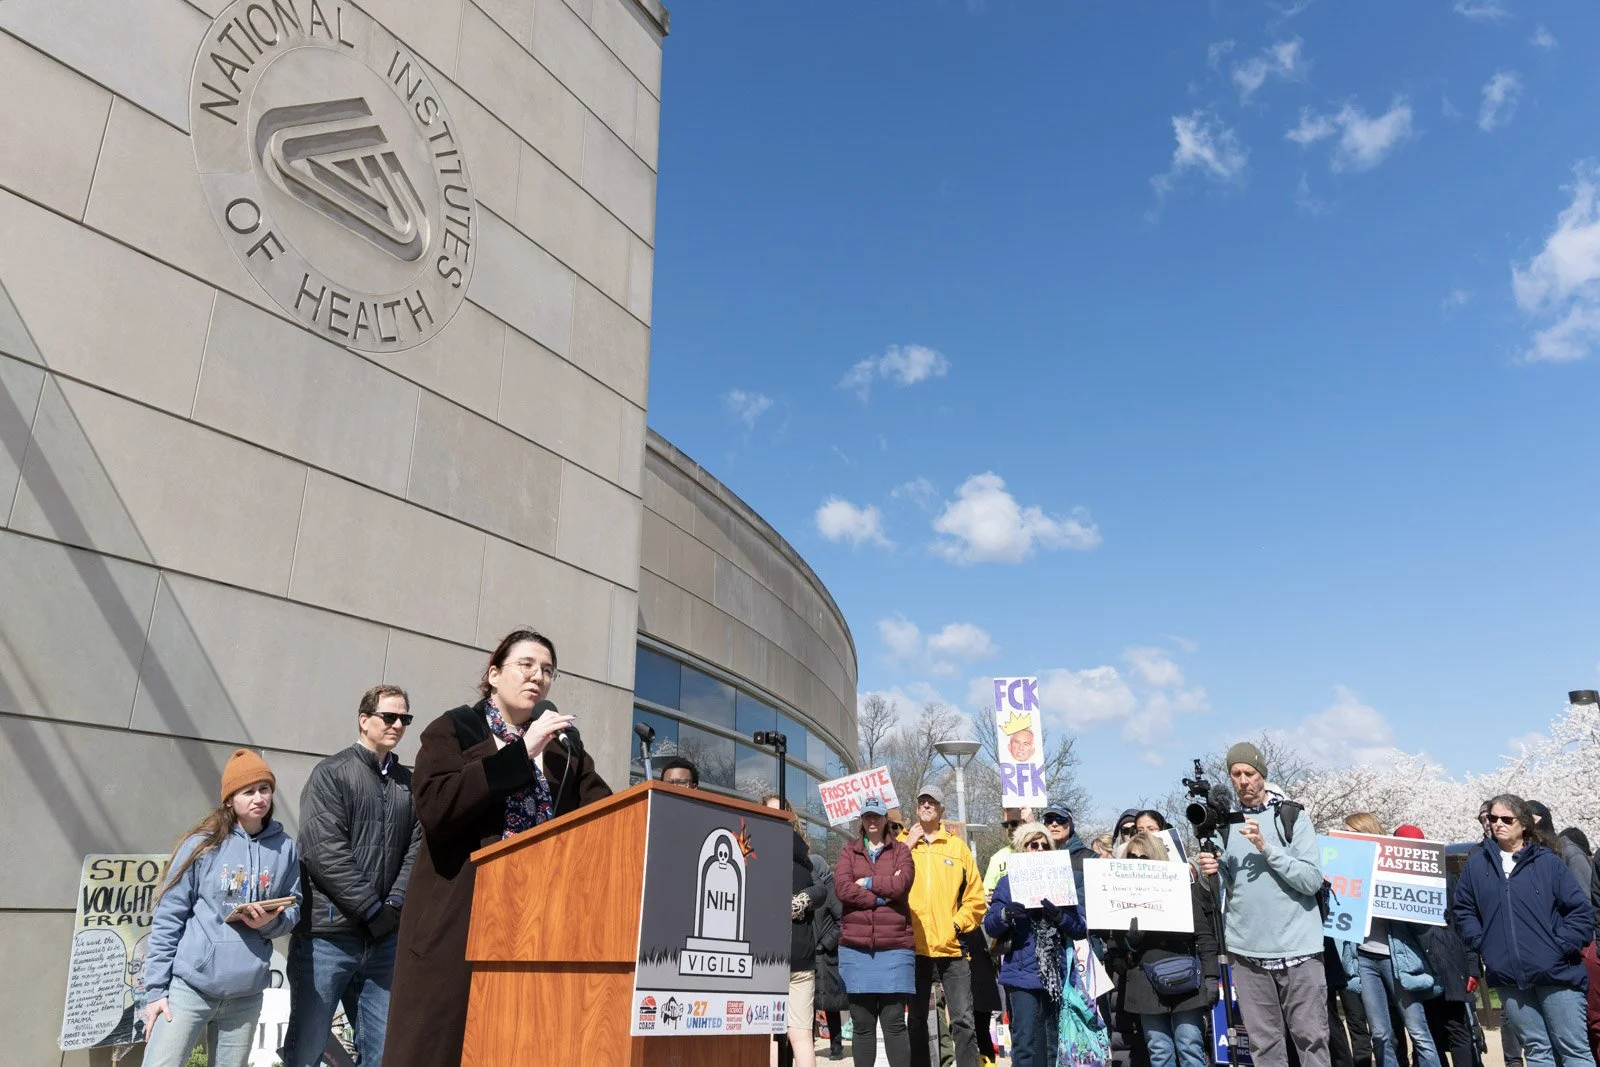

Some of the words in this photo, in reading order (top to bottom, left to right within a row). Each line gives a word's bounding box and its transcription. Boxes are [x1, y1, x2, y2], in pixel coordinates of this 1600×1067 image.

[200, 0, 354, 125] NATIONAL
[387, 50, 472, 289] INSTITUTES
[225, 197, 286, 262] OF
[294, 272, 434, 343] HEALTH
[994, 679, 1039, 711] FCK
[821, 769, 889, 803] PROSECUTE
[1000, 763, 1046, 796] RFK
[826, 796, 861, 819] THEM
[1384, 845, 1439, 861] PUPPET
[1323, 875, 1362, 898] RE
[1374, 884, 1443, 905] PEACH
[83, 884, 157, 915] VOUGHT
[706, 889, 736, 912] NIH
[1373, 900, 1398, 910] SELL
[84, 915, 153, 927] FRAU
[688, 954, 747, 974] VIGILS
[686, 1017, 722, 1029] UNIHTED
